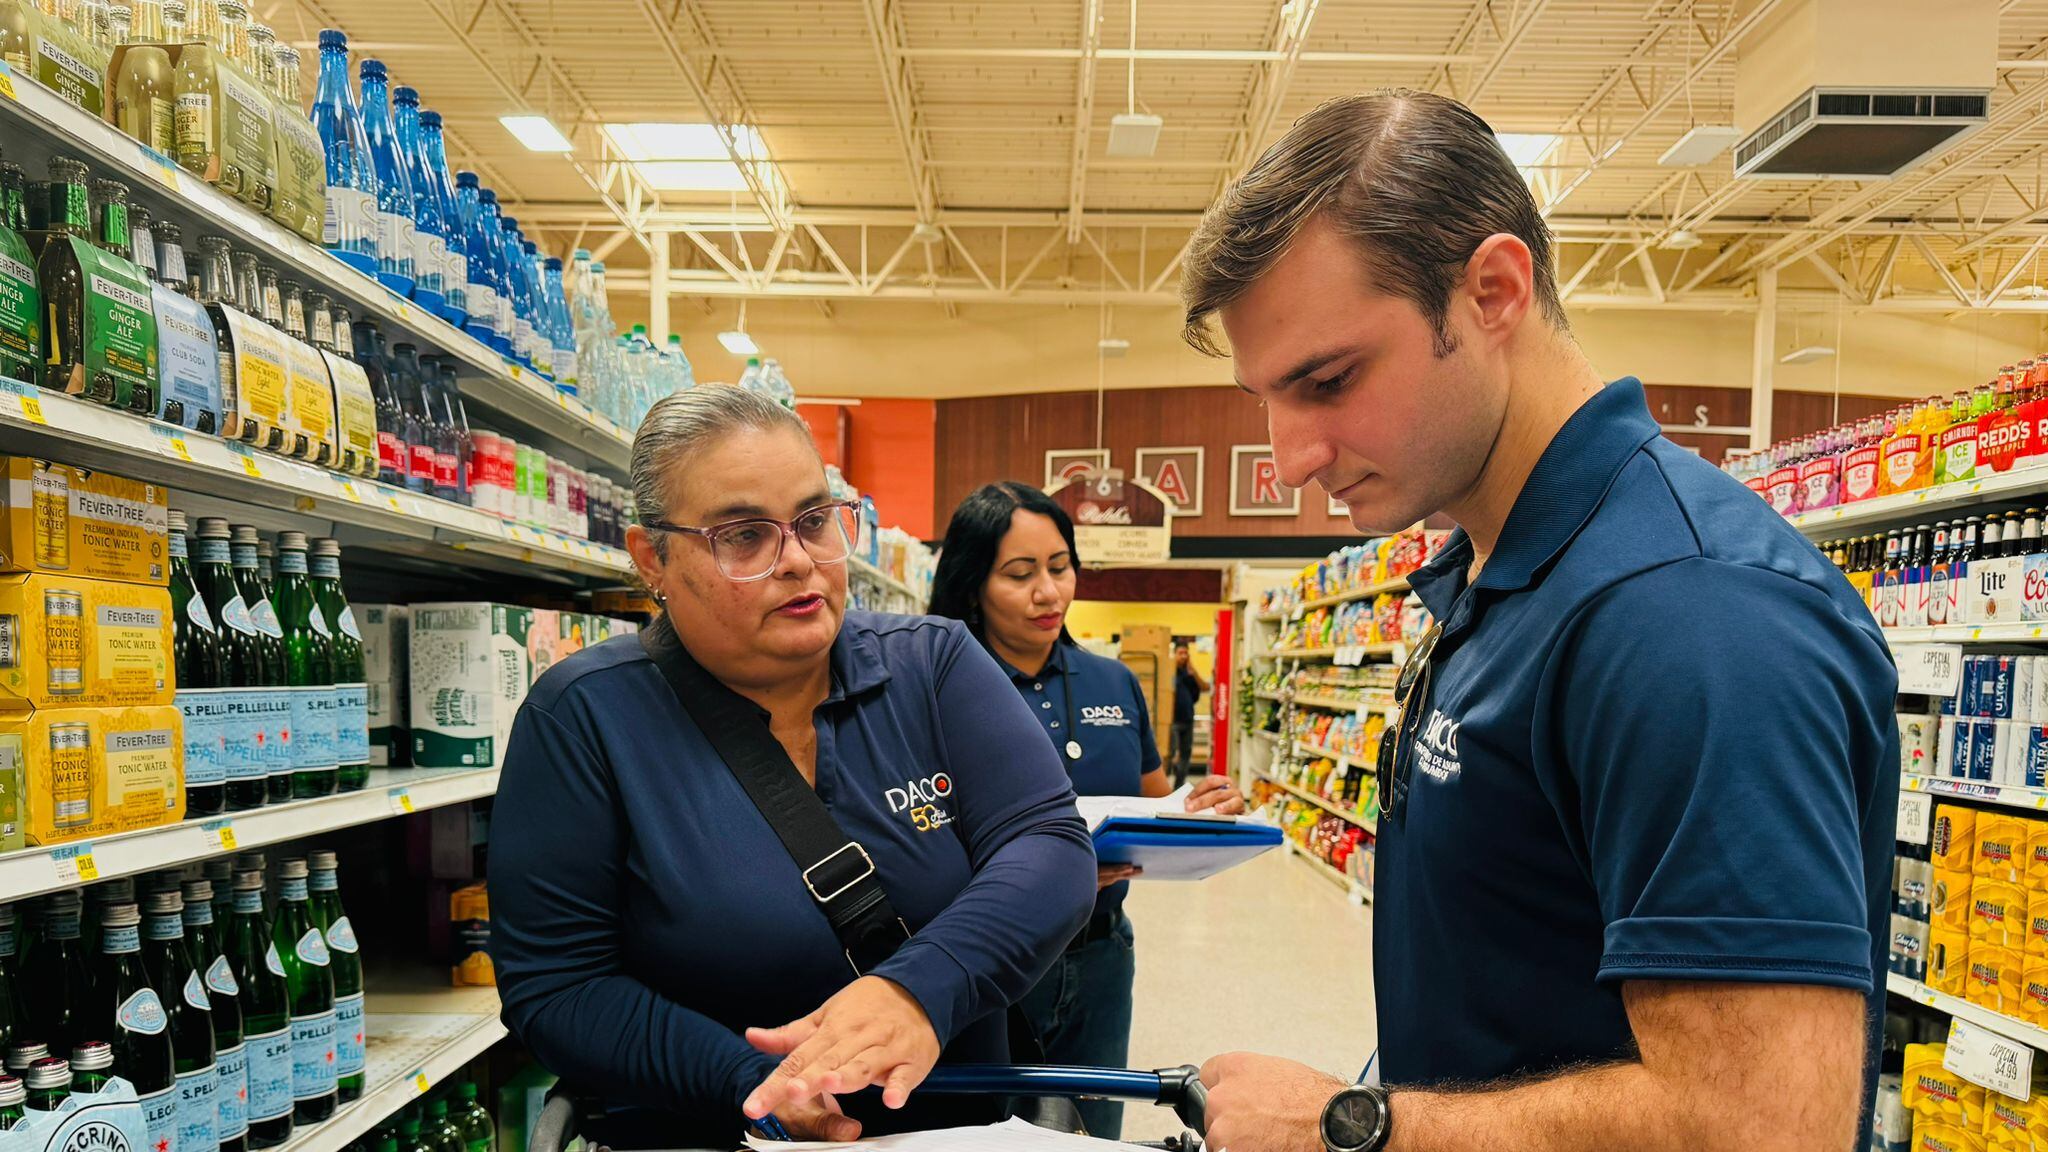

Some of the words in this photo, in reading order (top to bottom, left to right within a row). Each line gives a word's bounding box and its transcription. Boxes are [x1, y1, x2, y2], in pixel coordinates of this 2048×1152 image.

[42, 42, 95, 83] FEVER-TREE
[55, 72, 87, 99] GINGER
[60, 87, 83, 109] BEER
[228, 83, 268, 119] FEVER-TREE
[0, 258, 31, 282] ER-TREE
[0, 286, 24, 304] INGER
[96, 279, 150, 312] FEVER-TREE
[1, 299, 17, 314] ALE
[109, 309, 142, 331] GINGER
[116, 326, 134, 340] ALE
[164, 315, 209, 343] FEVER-TREE
[171, 346, 187, 361] CLUB
[189, 351, 206, 368] SODA
[1979, 420, 2031, 449] REDD'S
[1886, 437, 1918, 455] SMIRNOFF
[1952, 443, 1968, 459] ICE
[1982, 447, 2001, 458] HARD
[2002, 440, 2026, 454] APPLE
[1847, 449, 1878, 467] SMIRNOFF
[1894, 454, 1908, 468] ICE
[33, 475, 68, 491] FEVER-TREE
[1097, 474, 1112, 497] 6
[1811, 476, 1824, 488] ICE
[1775, 485, 1788, 496] ICE
[38, 504, 64, 519] TONIC
[79, 497, 144, 522] FEVER-TREE
[38, 518, 64, 531] WATER
[84, 524, 116, 537] PREMIUM
[82, 534, 110, 549] TONIC
[113, 537, 141, 552] WATER
[1981, 572, 2006, 597] Lite
[107, 610, 155, 624] FEVER-TREE
[50, 627, 79, 638] TONIC
[50, 640, 81, 650] WATER
[109, 640, 132, 649] TONIC
[133, 640, 156, 650] WATER
[1924, 651, 1951, 665] ESPECIAL
[1995, 673, 2006, 711] ULTRA
[1216, 682, 1227, 721] Colgate
[1081, 705, 1124, 719] DACO
[51, 735, 90, 744] FEVER-TREE
[116, 735, 166, 748] FEVER-TREE
[56, 760, 86, 771] TONIC
[131, 754, 155, 762] PREMIUM
[118, 765, 143, 774] TONIC
[144, 762, 168, 772] WATER
[55, 772, 89, 783] WATER
[885, 772, 953, 813] DACO
[1958, 781, 1985, 794] ULTRA
[1981, 841, 2011, 856] MEDALLA
[1975, 900, 2005, 916] MEDALLA
[2029, 982, 2048, 996] MEDA
[1989, 1042, 2019, 1062] ESPECIAL
[1994, 1059, 2018, 1080] $4.99
[1918, 1075, 1958, 1096] MEDALLA
[1994, 1103, 2026, 1126] MEDALLA
